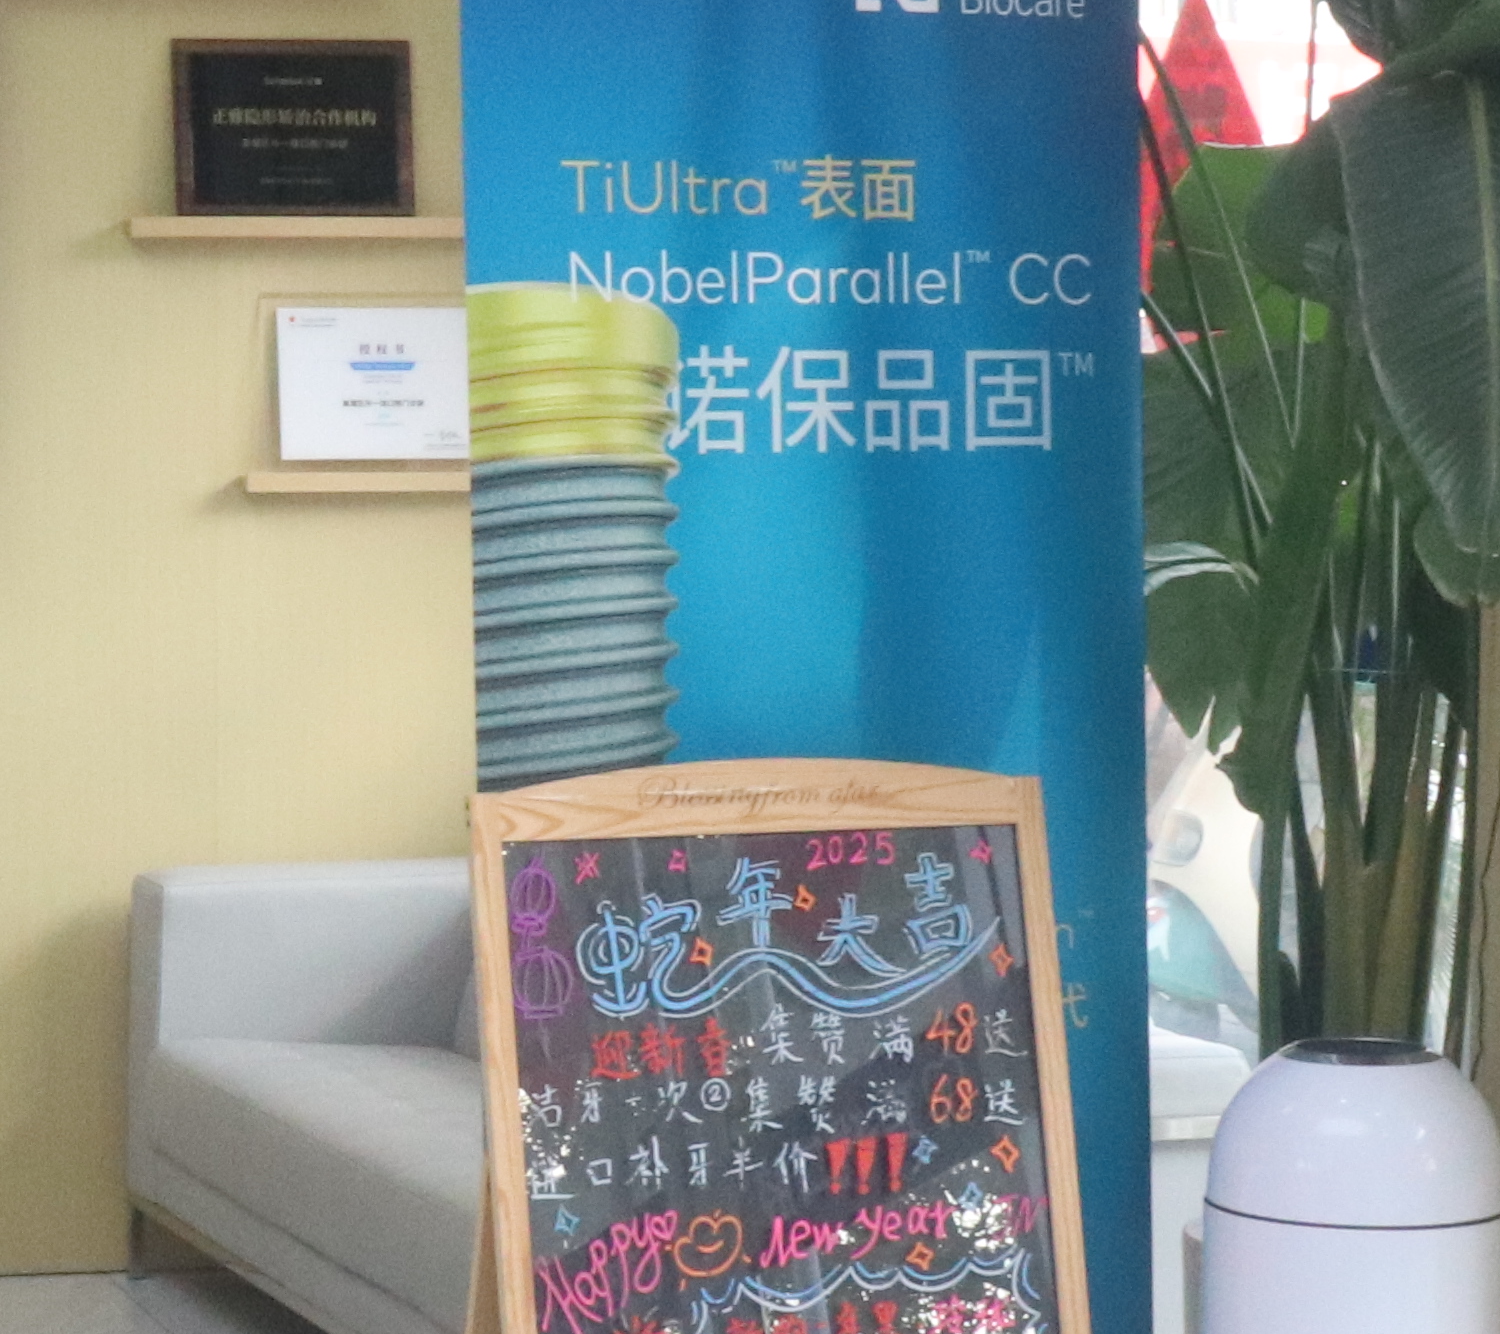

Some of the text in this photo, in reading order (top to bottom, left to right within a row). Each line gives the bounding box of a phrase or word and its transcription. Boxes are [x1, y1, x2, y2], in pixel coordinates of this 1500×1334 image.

[1009, 252, 1092, 306] CC
[806, 831, 897, 871] 2025
[574, 850, 990, 1019] 蛇年大吉
